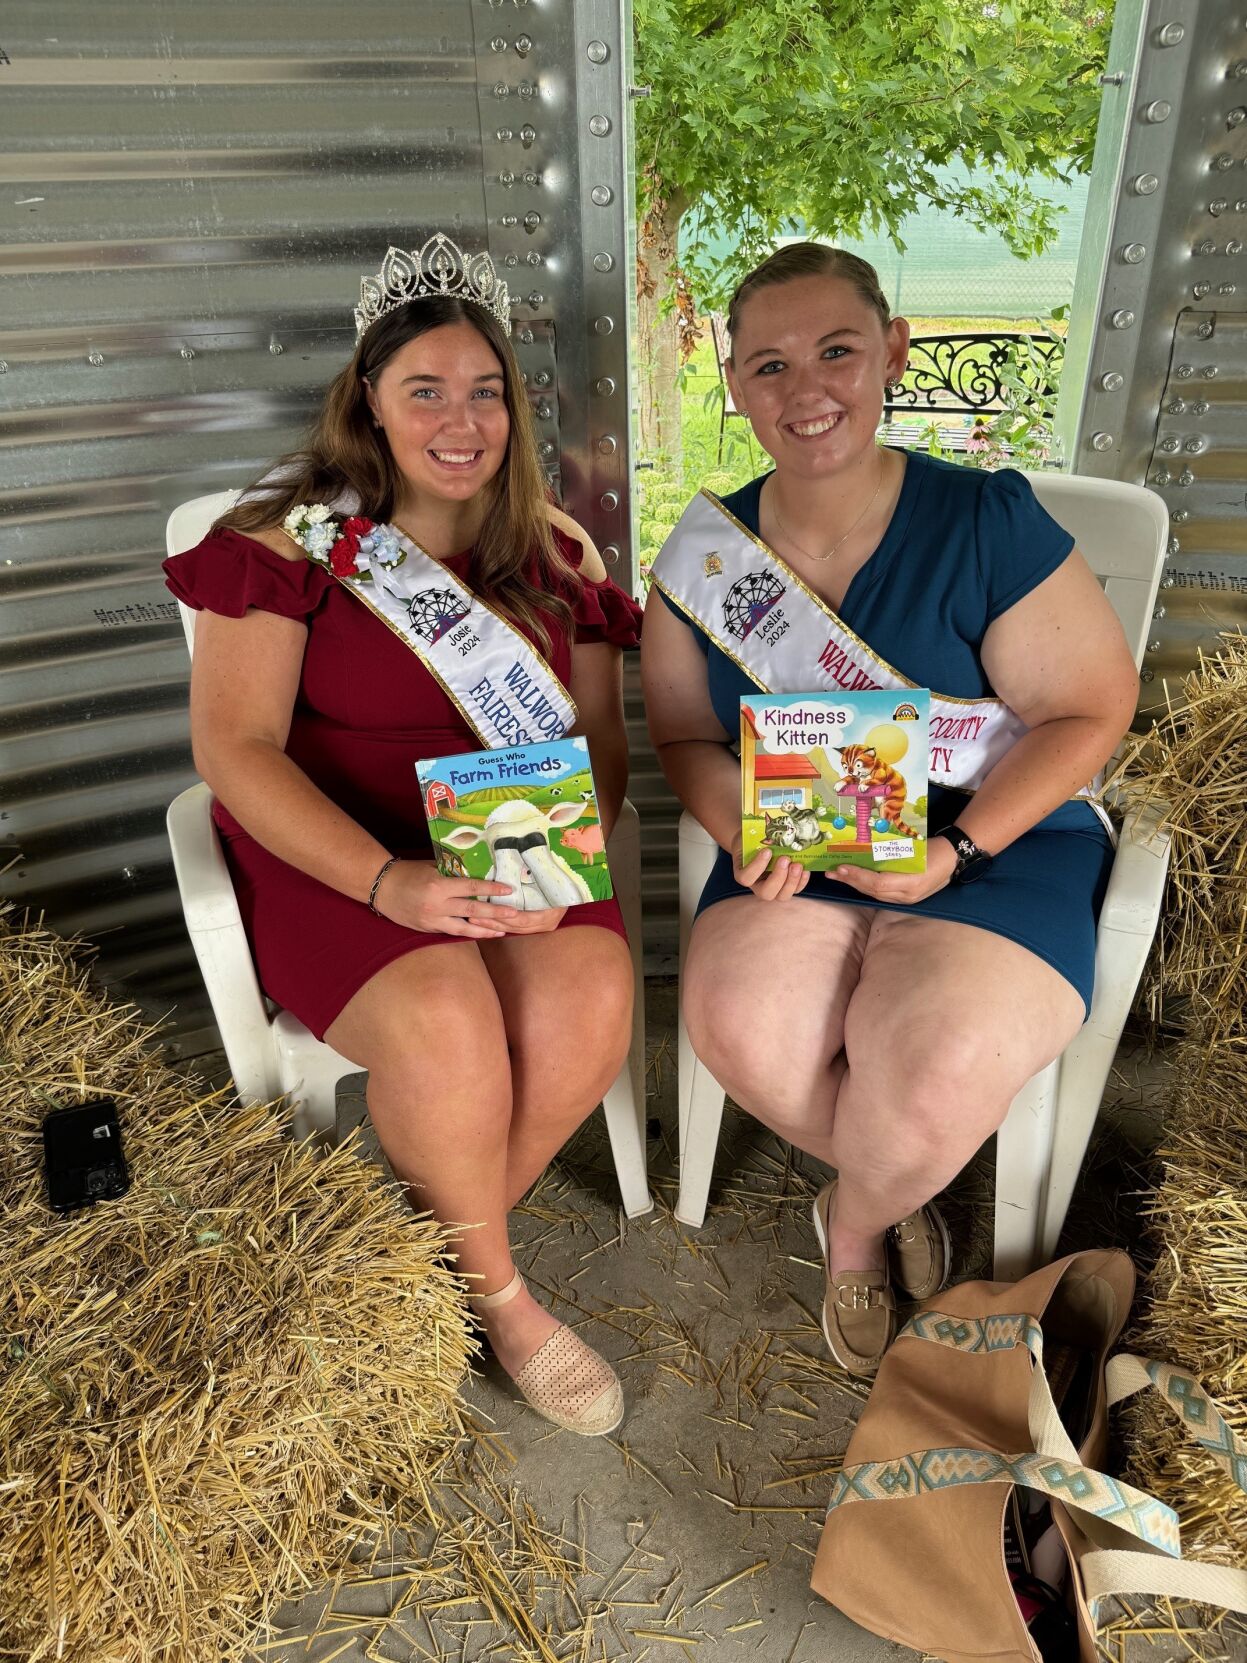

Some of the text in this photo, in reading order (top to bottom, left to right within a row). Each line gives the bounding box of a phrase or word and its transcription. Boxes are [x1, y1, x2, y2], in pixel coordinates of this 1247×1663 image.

[755, 607, 785, 640] Leslie
[766, 620, 791, 648] 2024
[450, 624, 472, 647] Josie
[458, 635, 481, 657] 2024
[817, 638, 988, 741] WALW COUNTY
[503, 661, 568, 742] WALWOR
[764, 709, 847, 726] Kindness
[777, 730, 829, 746] Kitten
[478, 752, 526, 765] Guess Who
[450, 757, 562, 786] Farm Friends
[874, 845, 914, 853] STORYBOOK
